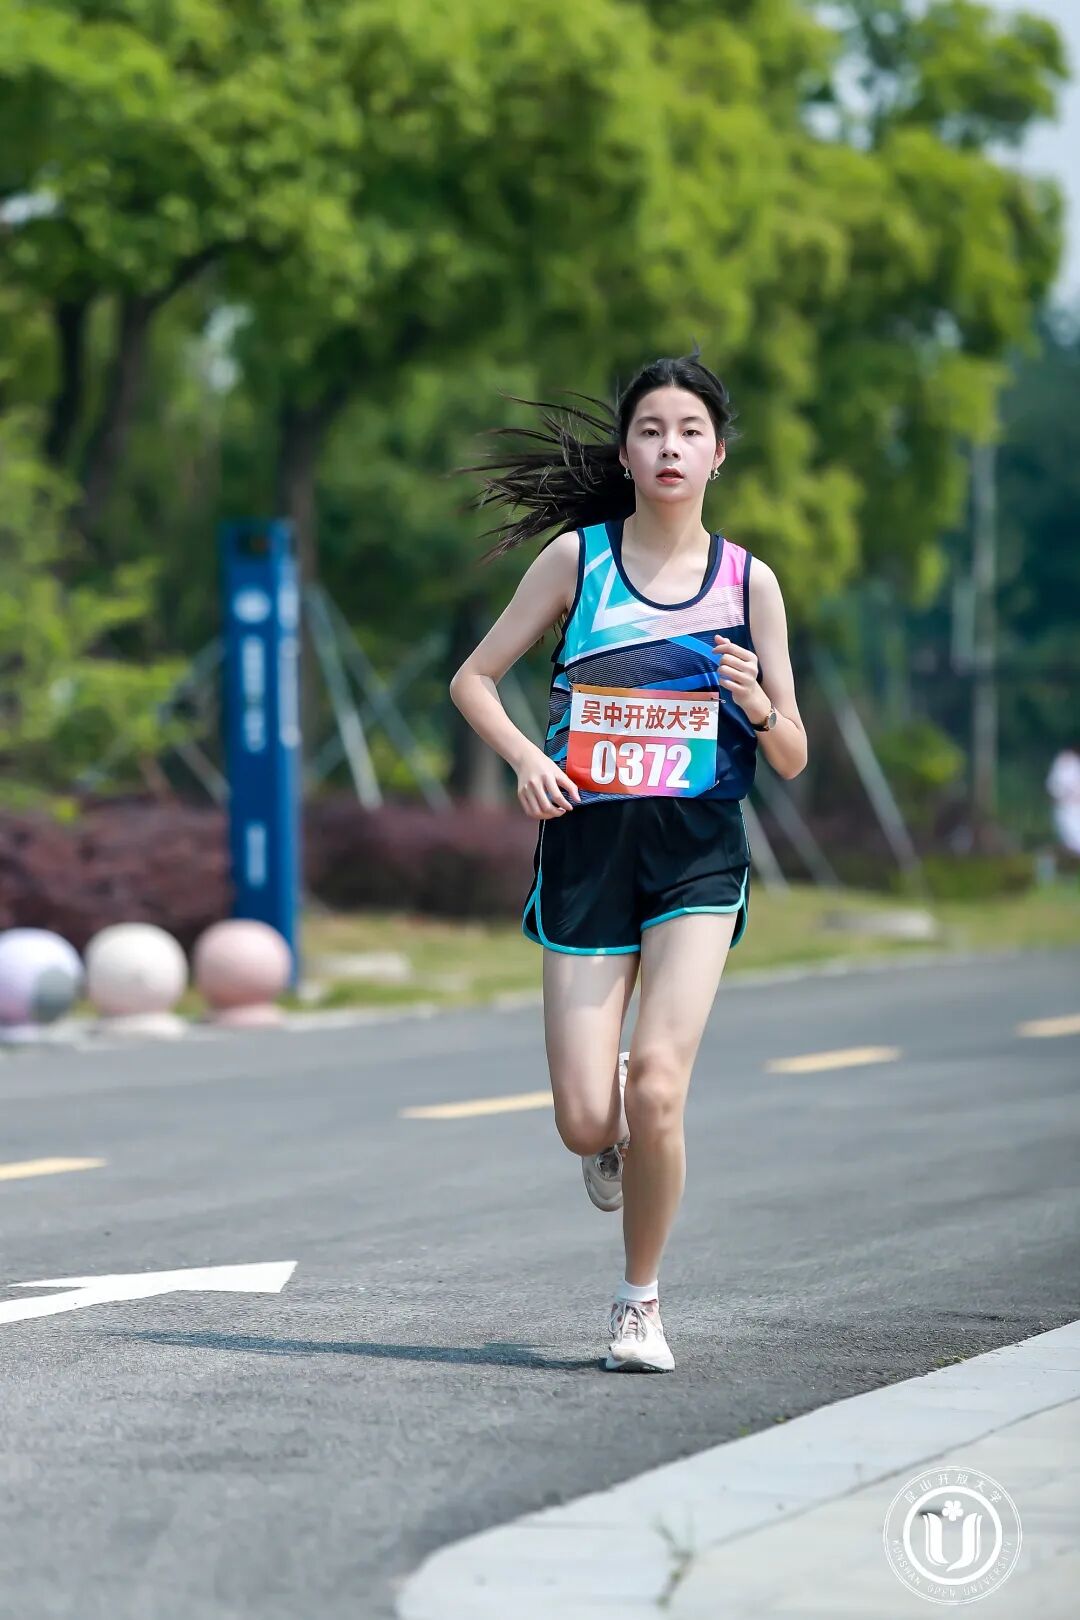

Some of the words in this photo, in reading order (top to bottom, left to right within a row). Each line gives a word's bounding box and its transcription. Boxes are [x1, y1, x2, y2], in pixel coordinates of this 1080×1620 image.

[581, 699, 709, 731] 吴中开放大学
[591, 740, 692, 788] 0372
